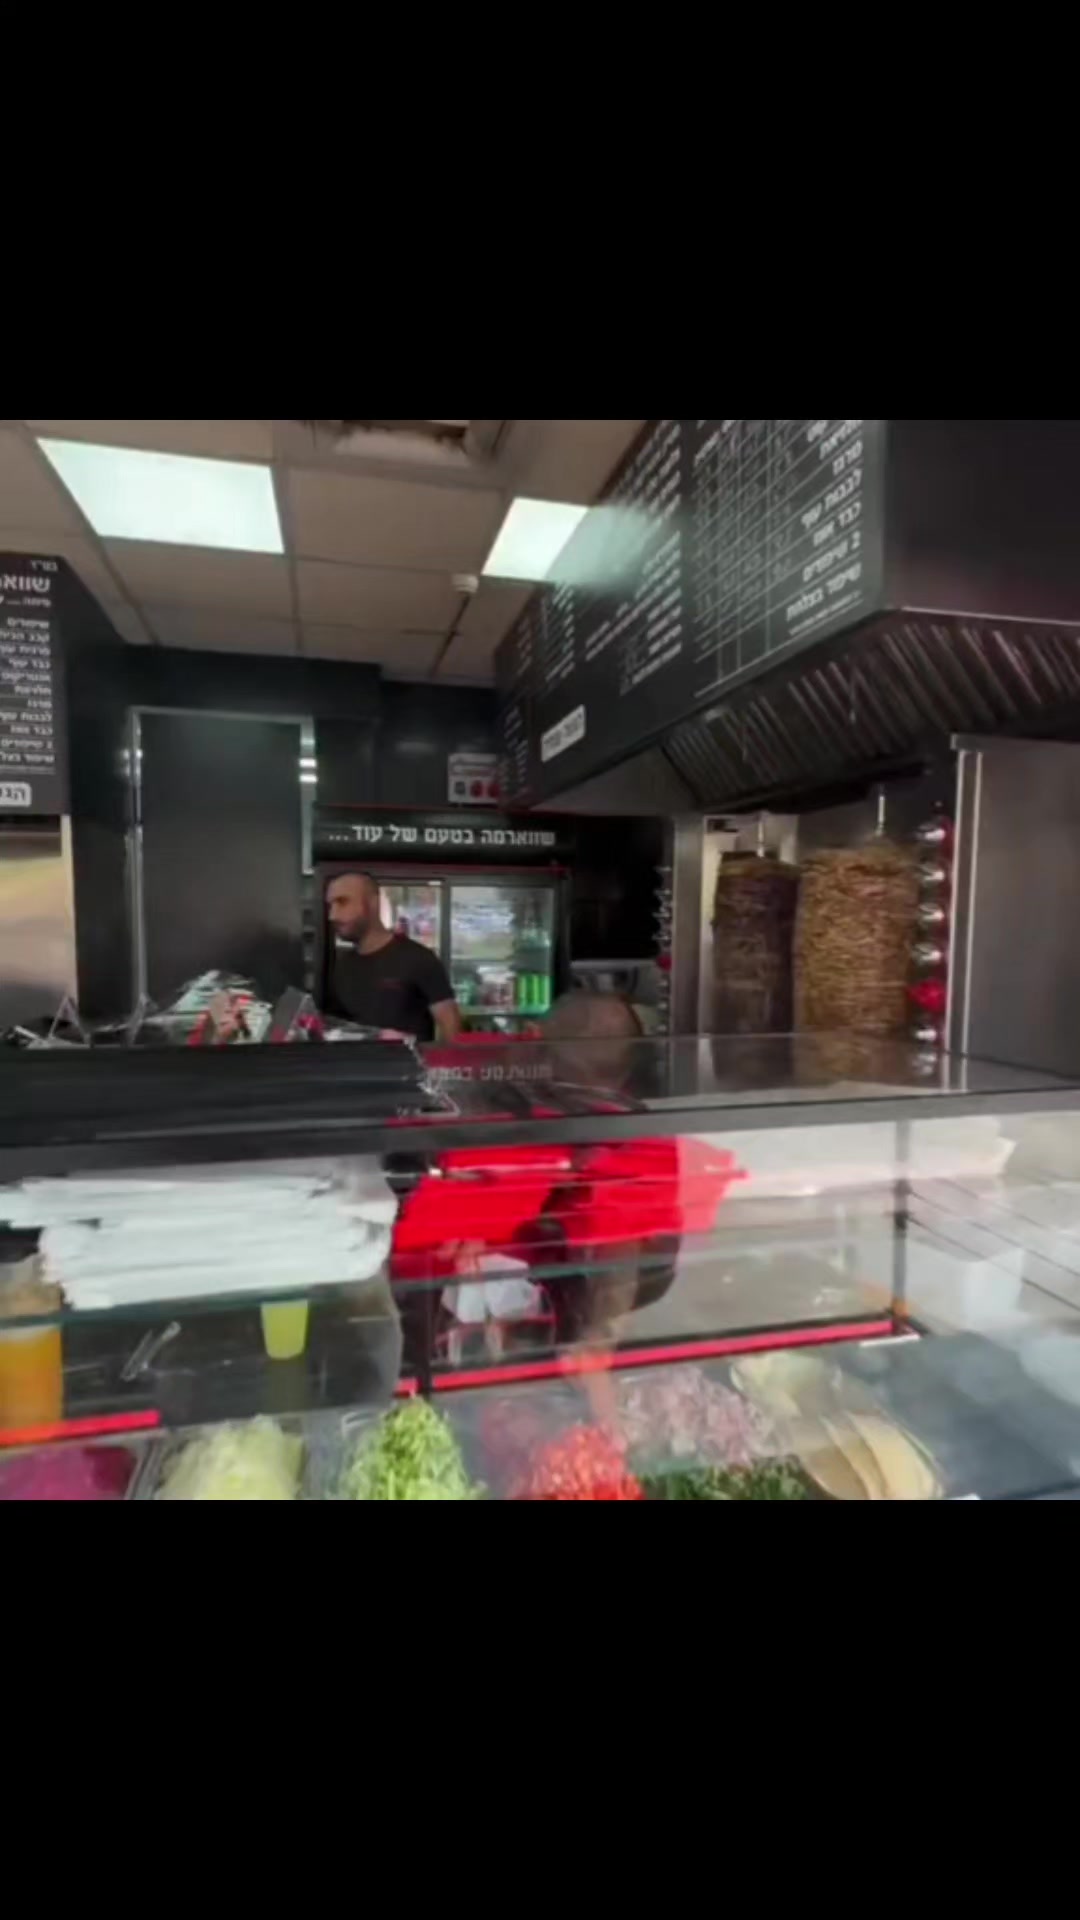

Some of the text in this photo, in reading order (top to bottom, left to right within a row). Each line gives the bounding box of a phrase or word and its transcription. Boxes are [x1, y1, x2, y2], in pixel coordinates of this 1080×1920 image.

[0, 574, 50, 593] שווא
[389, 823, 418, 843] של
[424, 827, 475, 845] בטעם
[480, 830, 556, 846] שווארמה
